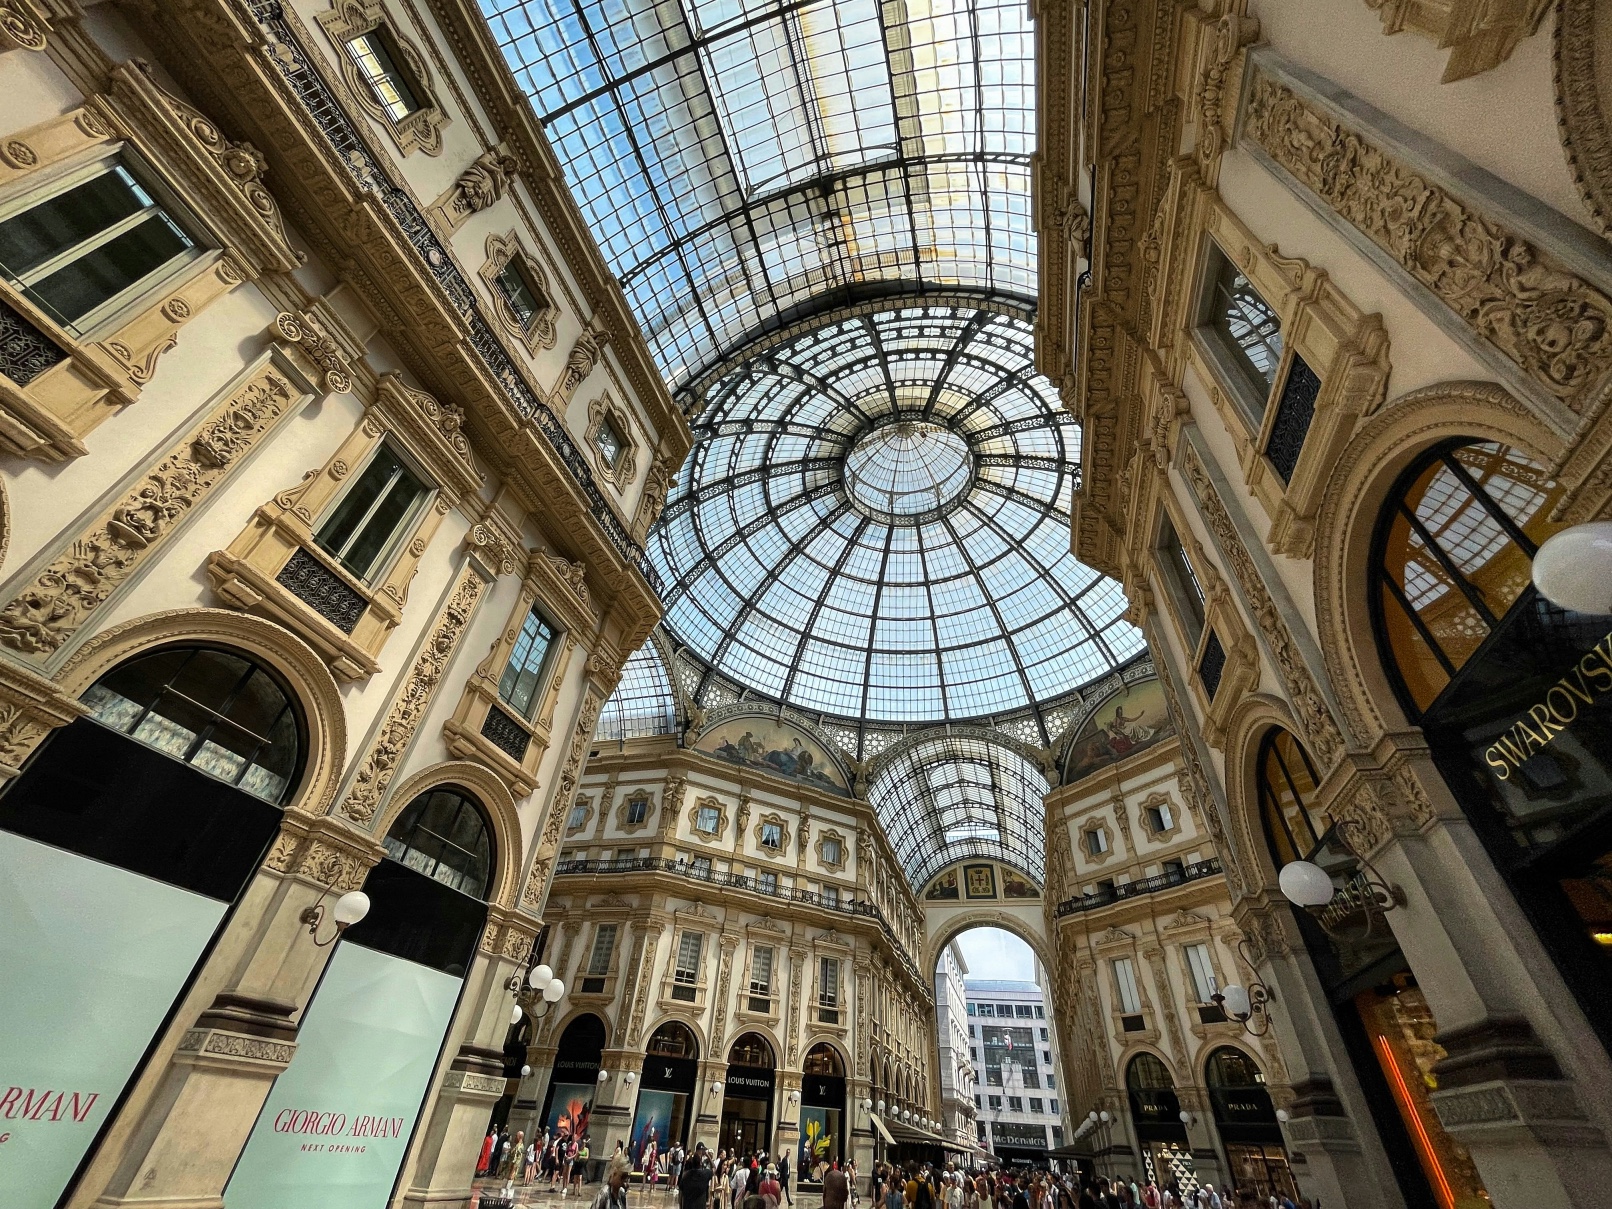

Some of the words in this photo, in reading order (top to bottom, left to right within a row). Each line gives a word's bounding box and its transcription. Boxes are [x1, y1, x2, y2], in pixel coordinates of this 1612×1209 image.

[557, 1060, 575, 1068] LOUIS
[728, 1076, 745, 1085] LOUIS
[745, 1078, 770, 1088] VUITTON
[274, 1108, 346, 1136] GIORGIO
[345, 1115, 404, 1138] ARMANI
[993, 1134, 1046, 1146] McDonald's
[301, 1143, 325, 1152] NEXT
[328, 1144, 366, 1153] OPENING
